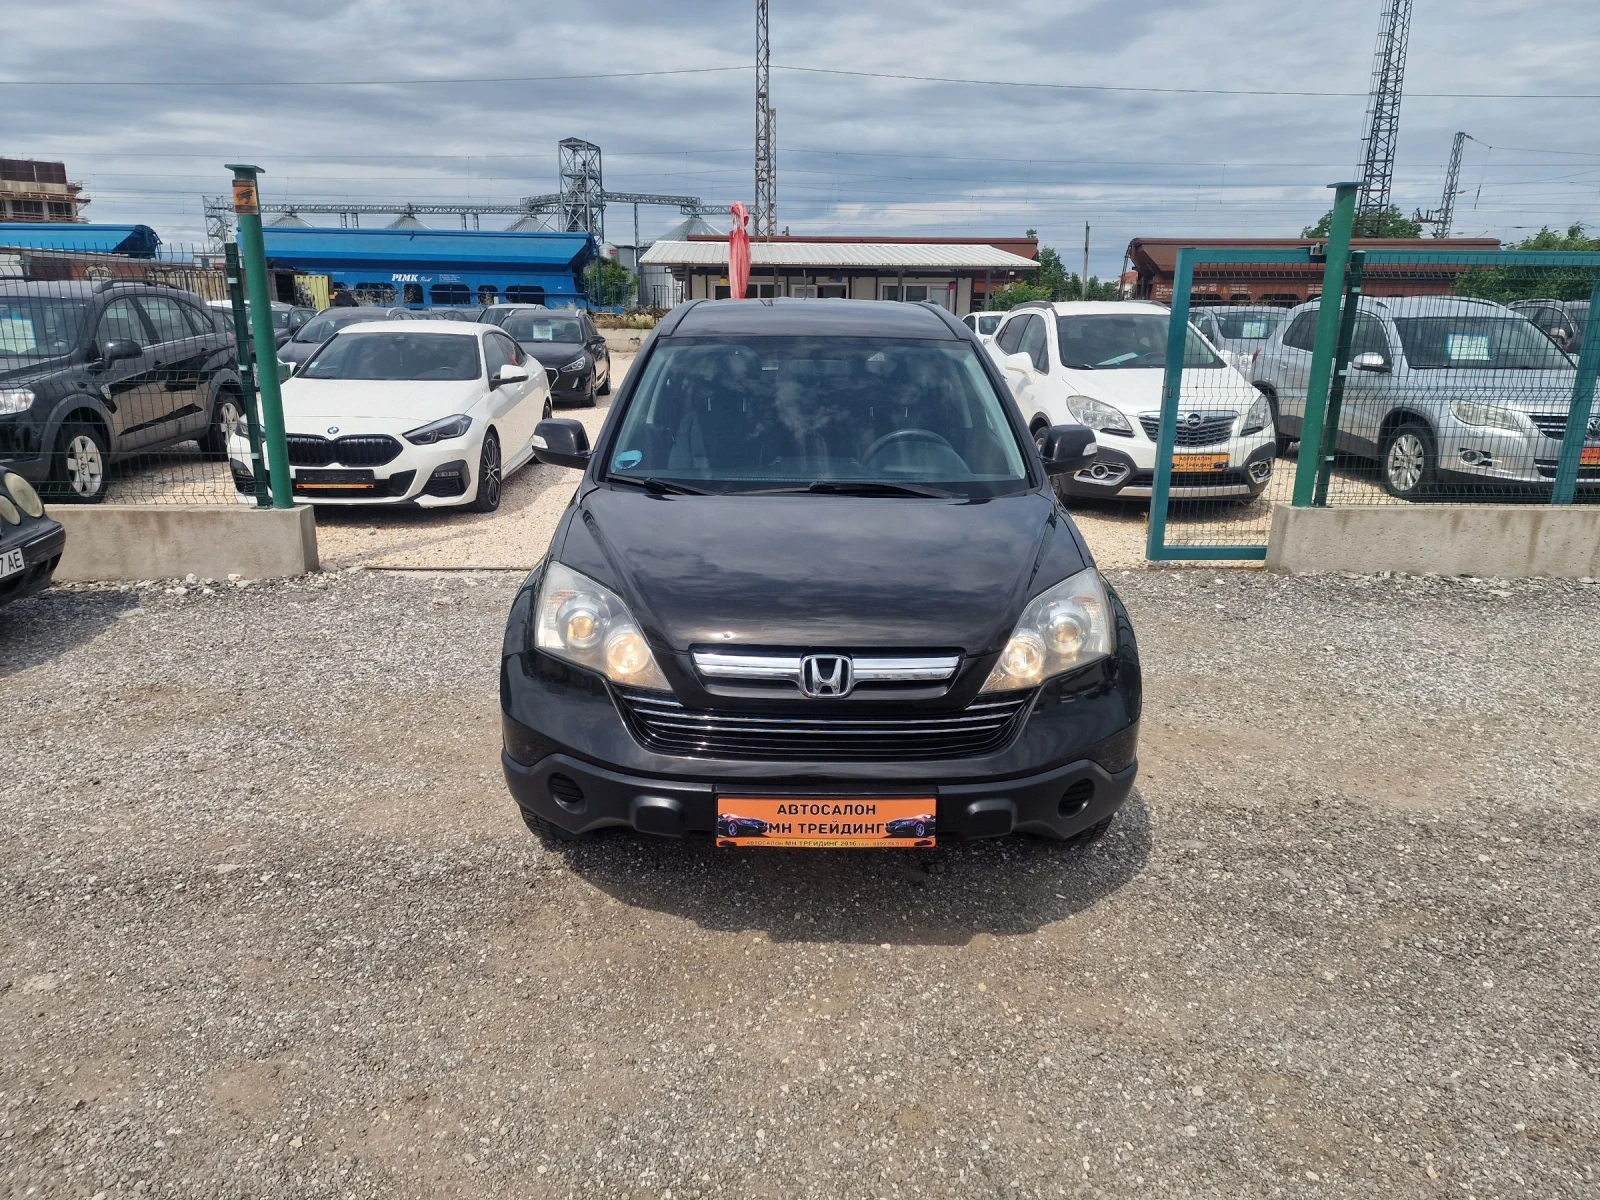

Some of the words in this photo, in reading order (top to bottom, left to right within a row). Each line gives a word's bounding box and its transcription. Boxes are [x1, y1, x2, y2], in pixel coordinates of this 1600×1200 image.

[391, 273, 419, 282] PIMK
[776, 803, 877, 816] АВТОСАЛОН
[769, 822, 792, 834] МН
[797, 819, 885, 836] ТРЕЙДИНГ
